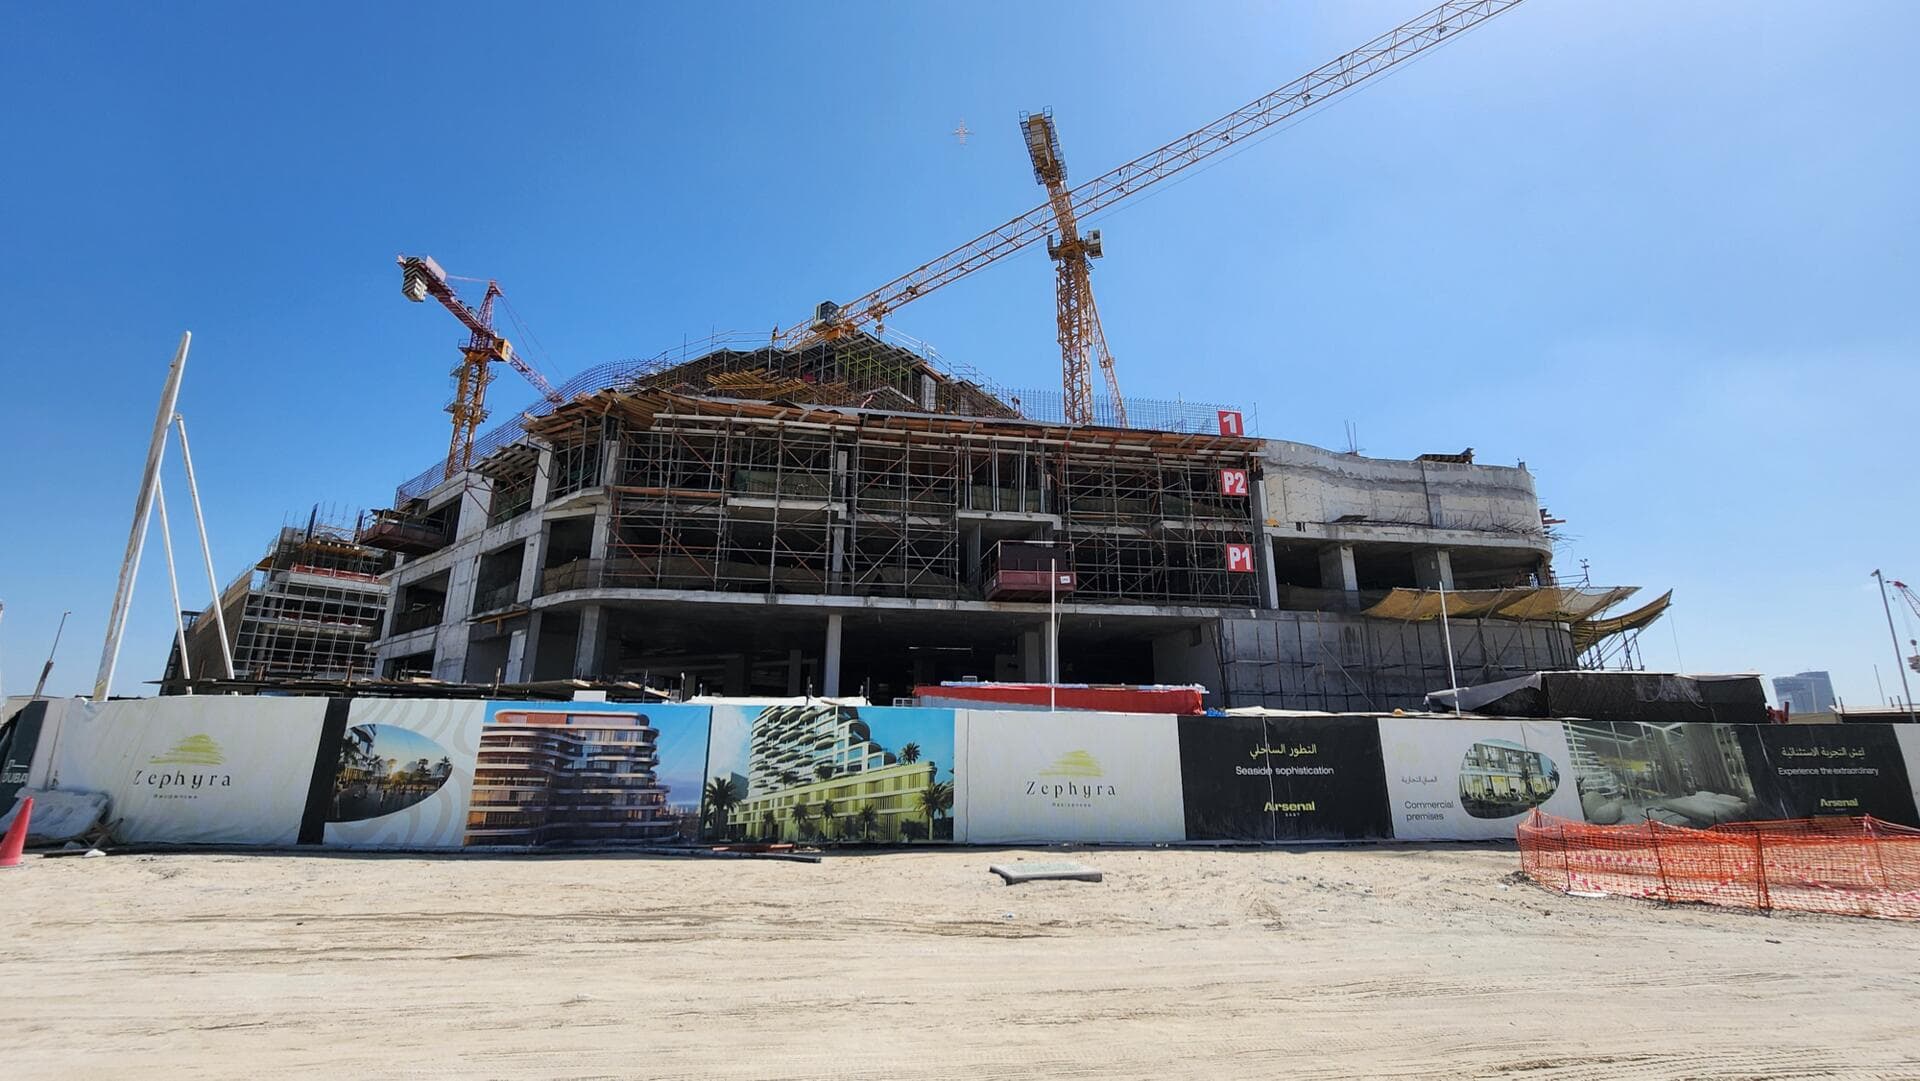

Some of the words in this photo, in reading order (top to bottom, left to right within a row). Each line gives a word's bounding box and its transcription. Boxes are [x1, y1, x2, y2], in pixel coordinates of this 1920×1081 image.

[1223, 413, 1238, 434] 1
[1223, 471, 1246, 494] P2
[1229, 546, 1252, 570] P1
[1235, 765, 1273, 776] Seaside
[1275, 765, 1335, 777] sophistication
[1778, 767, 1820, 777] Experience
[1820, 767, 1833, 775] the
[133, 769, 231, 790] Zephyra
[1025, 780, 1116, 799] Zephyra
[1263, 800, 1316, 812] Arsenal
[1404, 800, 1454, 810] Commercial
[1820, 797, 1859, 807] Arsenal
[1406, 811, 1445, 823] premises
